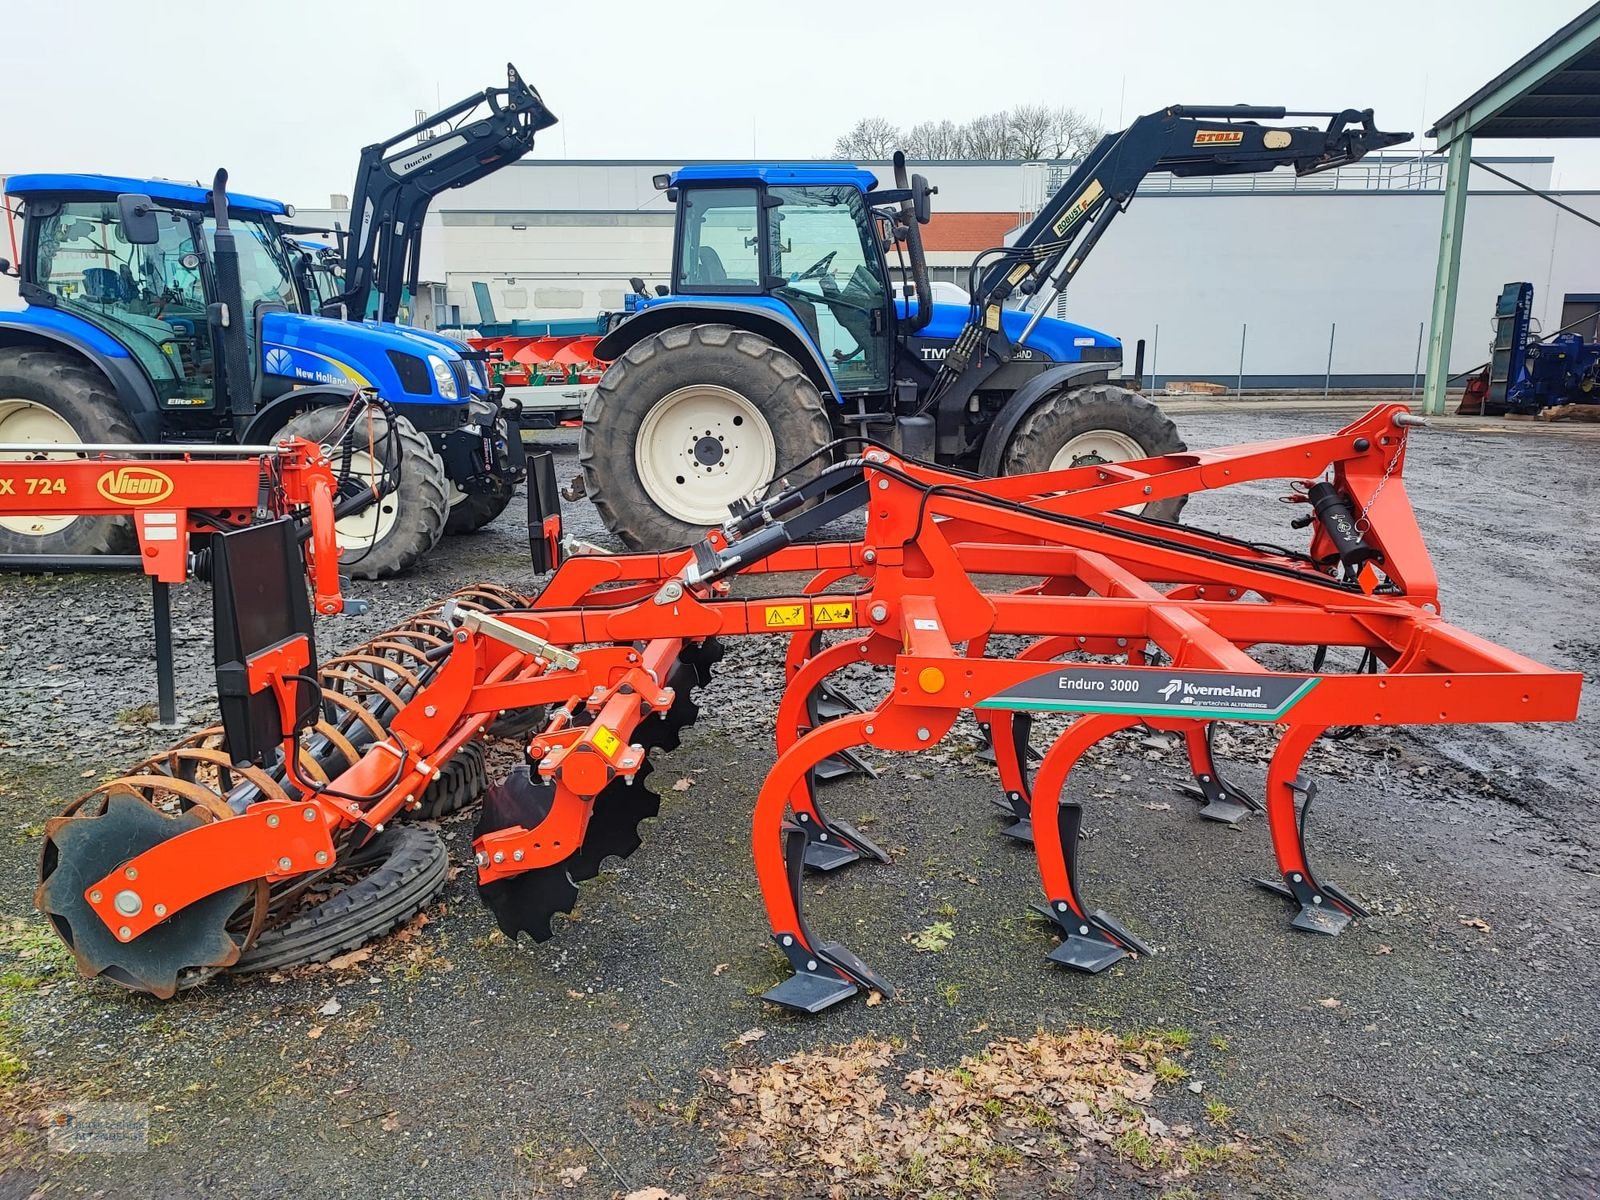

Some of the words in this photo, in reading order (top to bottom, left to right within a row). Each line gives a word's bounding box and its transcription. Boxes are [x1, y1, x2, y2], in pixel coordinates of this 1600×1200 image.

[1196, 133, 1241, 142] STOLL
[404, 153, 433, 170] Quicke
[1057, 204, 1083, 231] ROBUST
[921, 348, 951, 359] TM
[295, 367, 314, 379] New
[315, 371, 347, 384] Holland
[25, 478, 67, 495] 724
[107, 467, 164, 495] Vicon
[1058, 676, 1105, 690] Enduro
[1109, 679, 1140, 692] 3000
[1183, 682, 1262, 698] Kverneland
